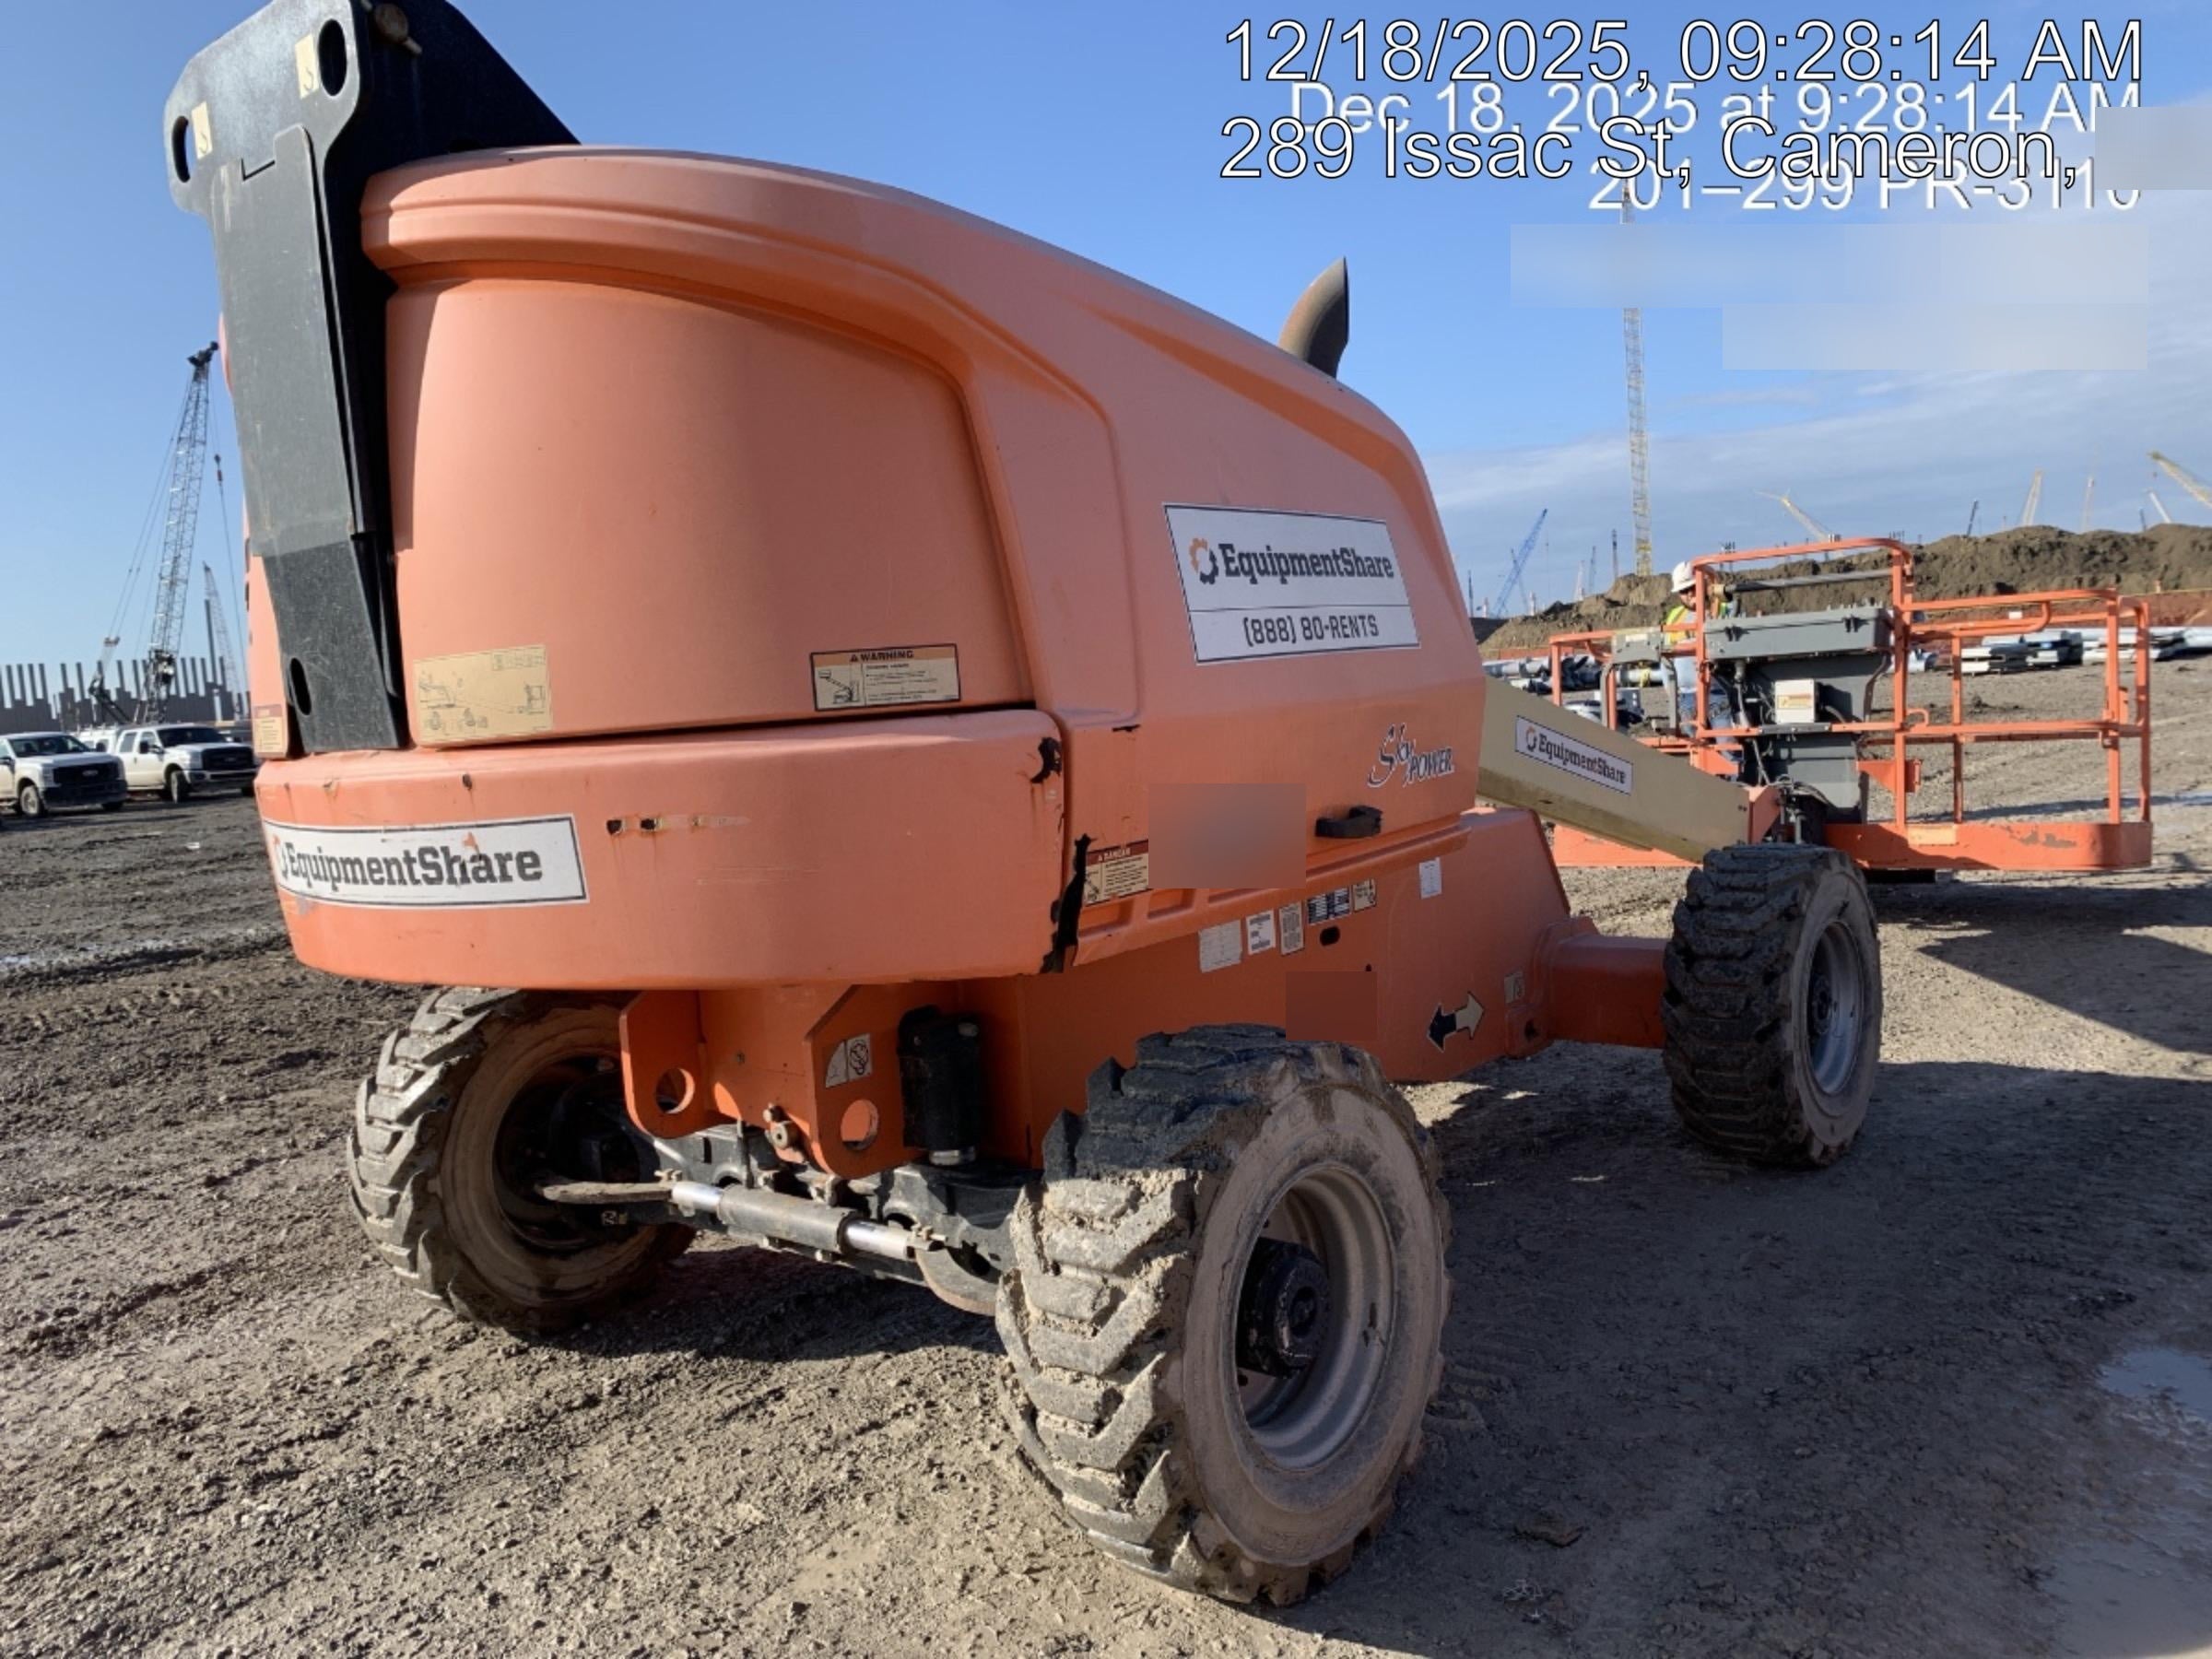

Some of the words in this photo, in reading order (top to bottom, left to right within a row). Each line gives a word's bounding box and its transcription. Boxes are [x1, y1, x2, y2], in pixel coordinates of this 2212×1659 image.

[1218, 543, 1394, 584] EquipmentShare
[1242, 615, 1297, 647] (888)
[1300, 614, 1380, 641] 80-RENTS
[860, 649, 915, 662] WARNING
[1538, 734, 1627, 784] EquipmentShare
[283, 841, 544, 892] EquipmentShare
